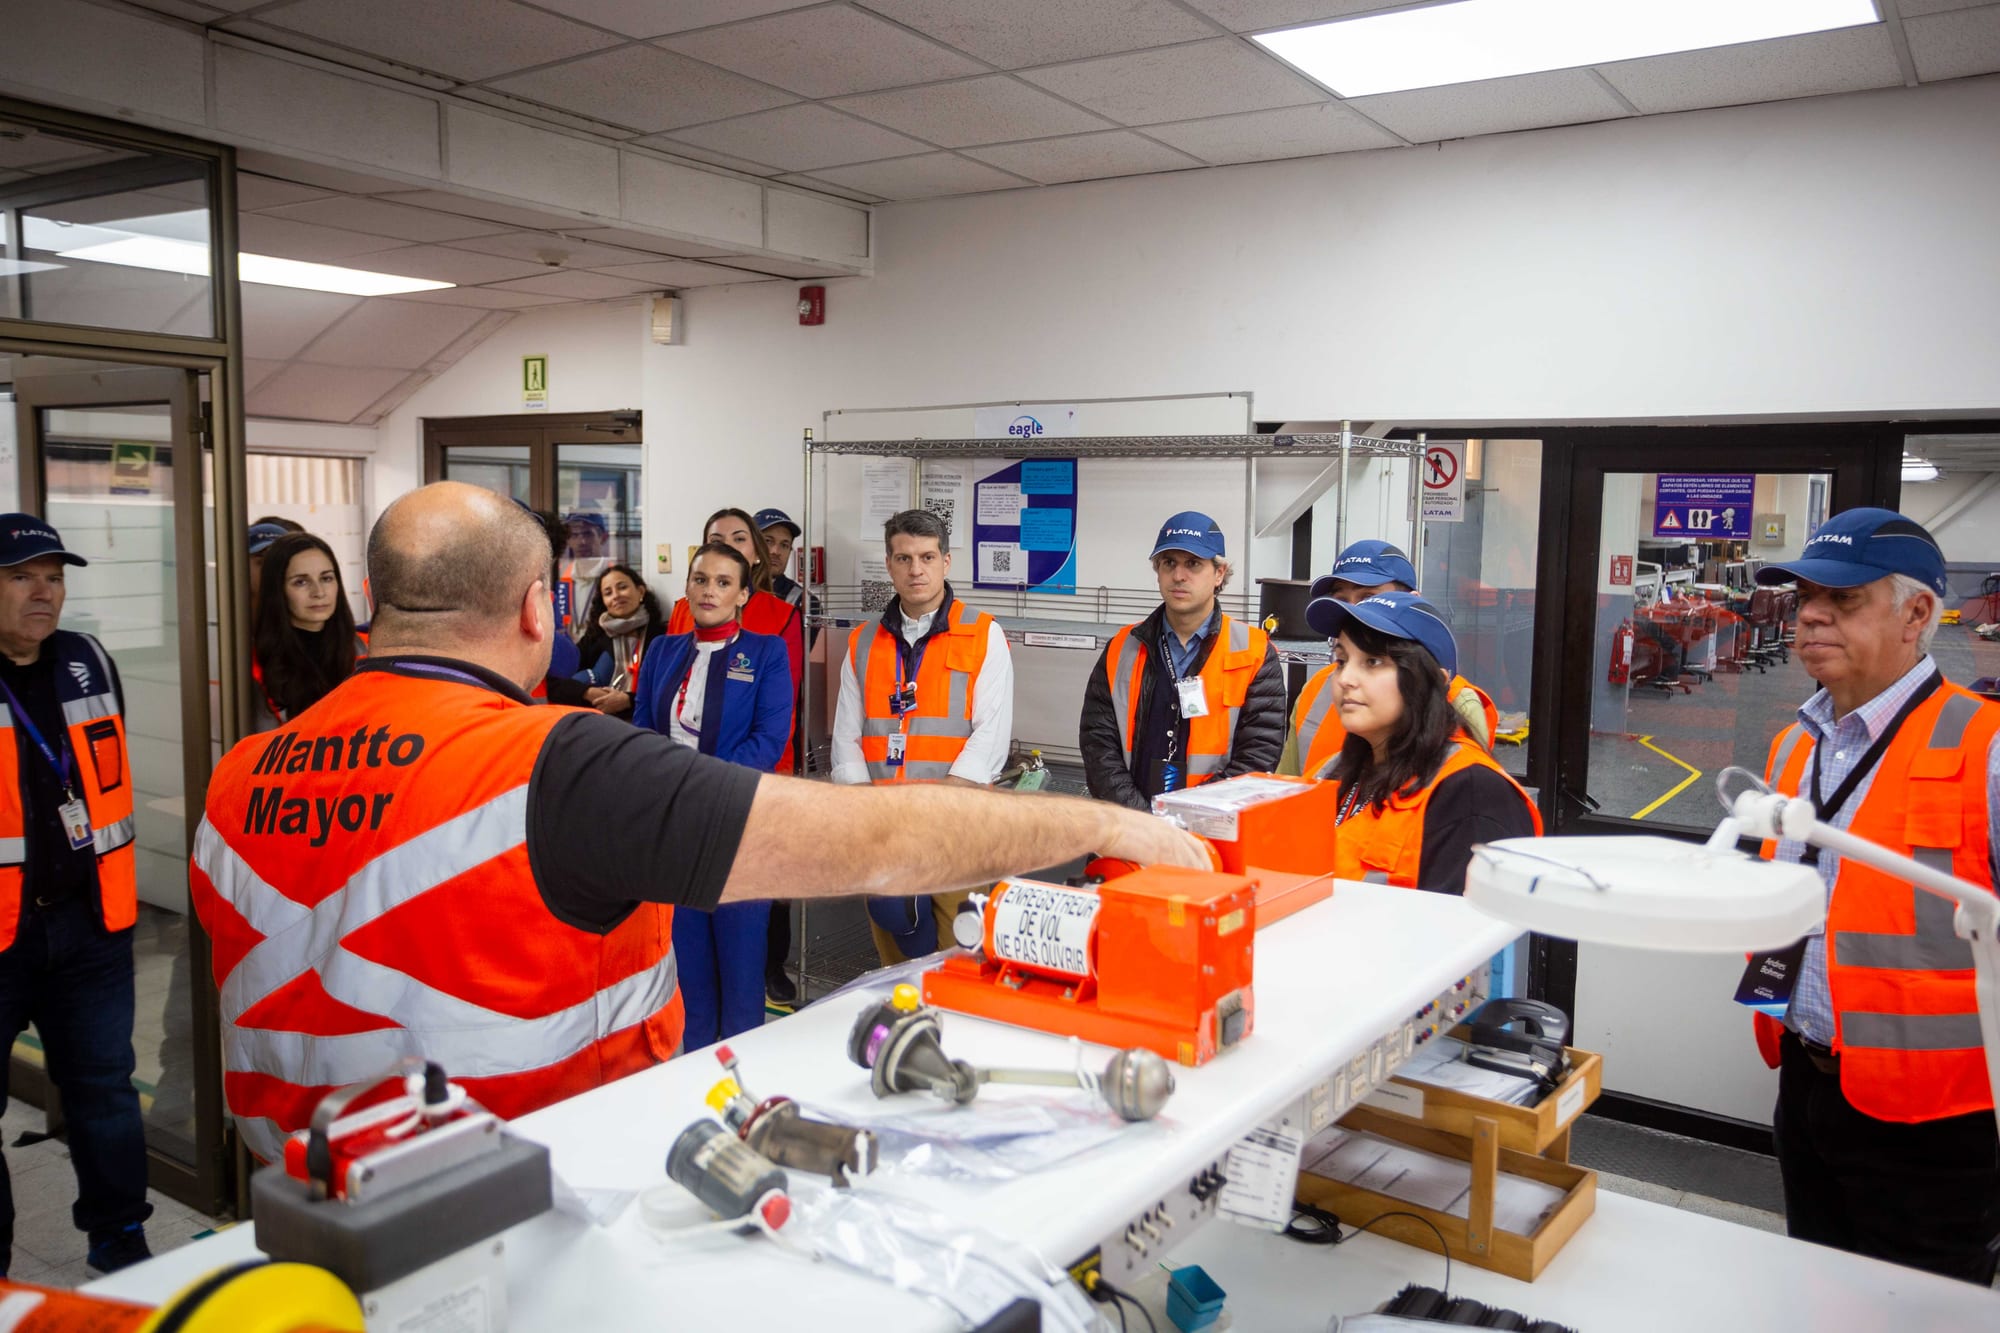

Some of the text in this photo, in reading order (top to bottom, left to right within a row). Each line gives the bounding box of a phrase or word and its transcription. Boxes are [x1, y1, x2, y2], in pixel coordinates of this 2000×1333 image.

[1008, 420, 1043, 439] eagle
[1172, 528, 1202, 537] LATAM
[1810, 534, 1853, 546] LATAM
[1340, 556, 1372, 566] LATAM
[252, 723, 425, 775] Mantto
[243, 787, 394, 848] Mayor
[1004, 884, 1099, 918] ENREGISTREUR
[1018, 909, 1061, 942] DE VOL
[996, 931, 1086, 973] NE PAS OUVRIR
